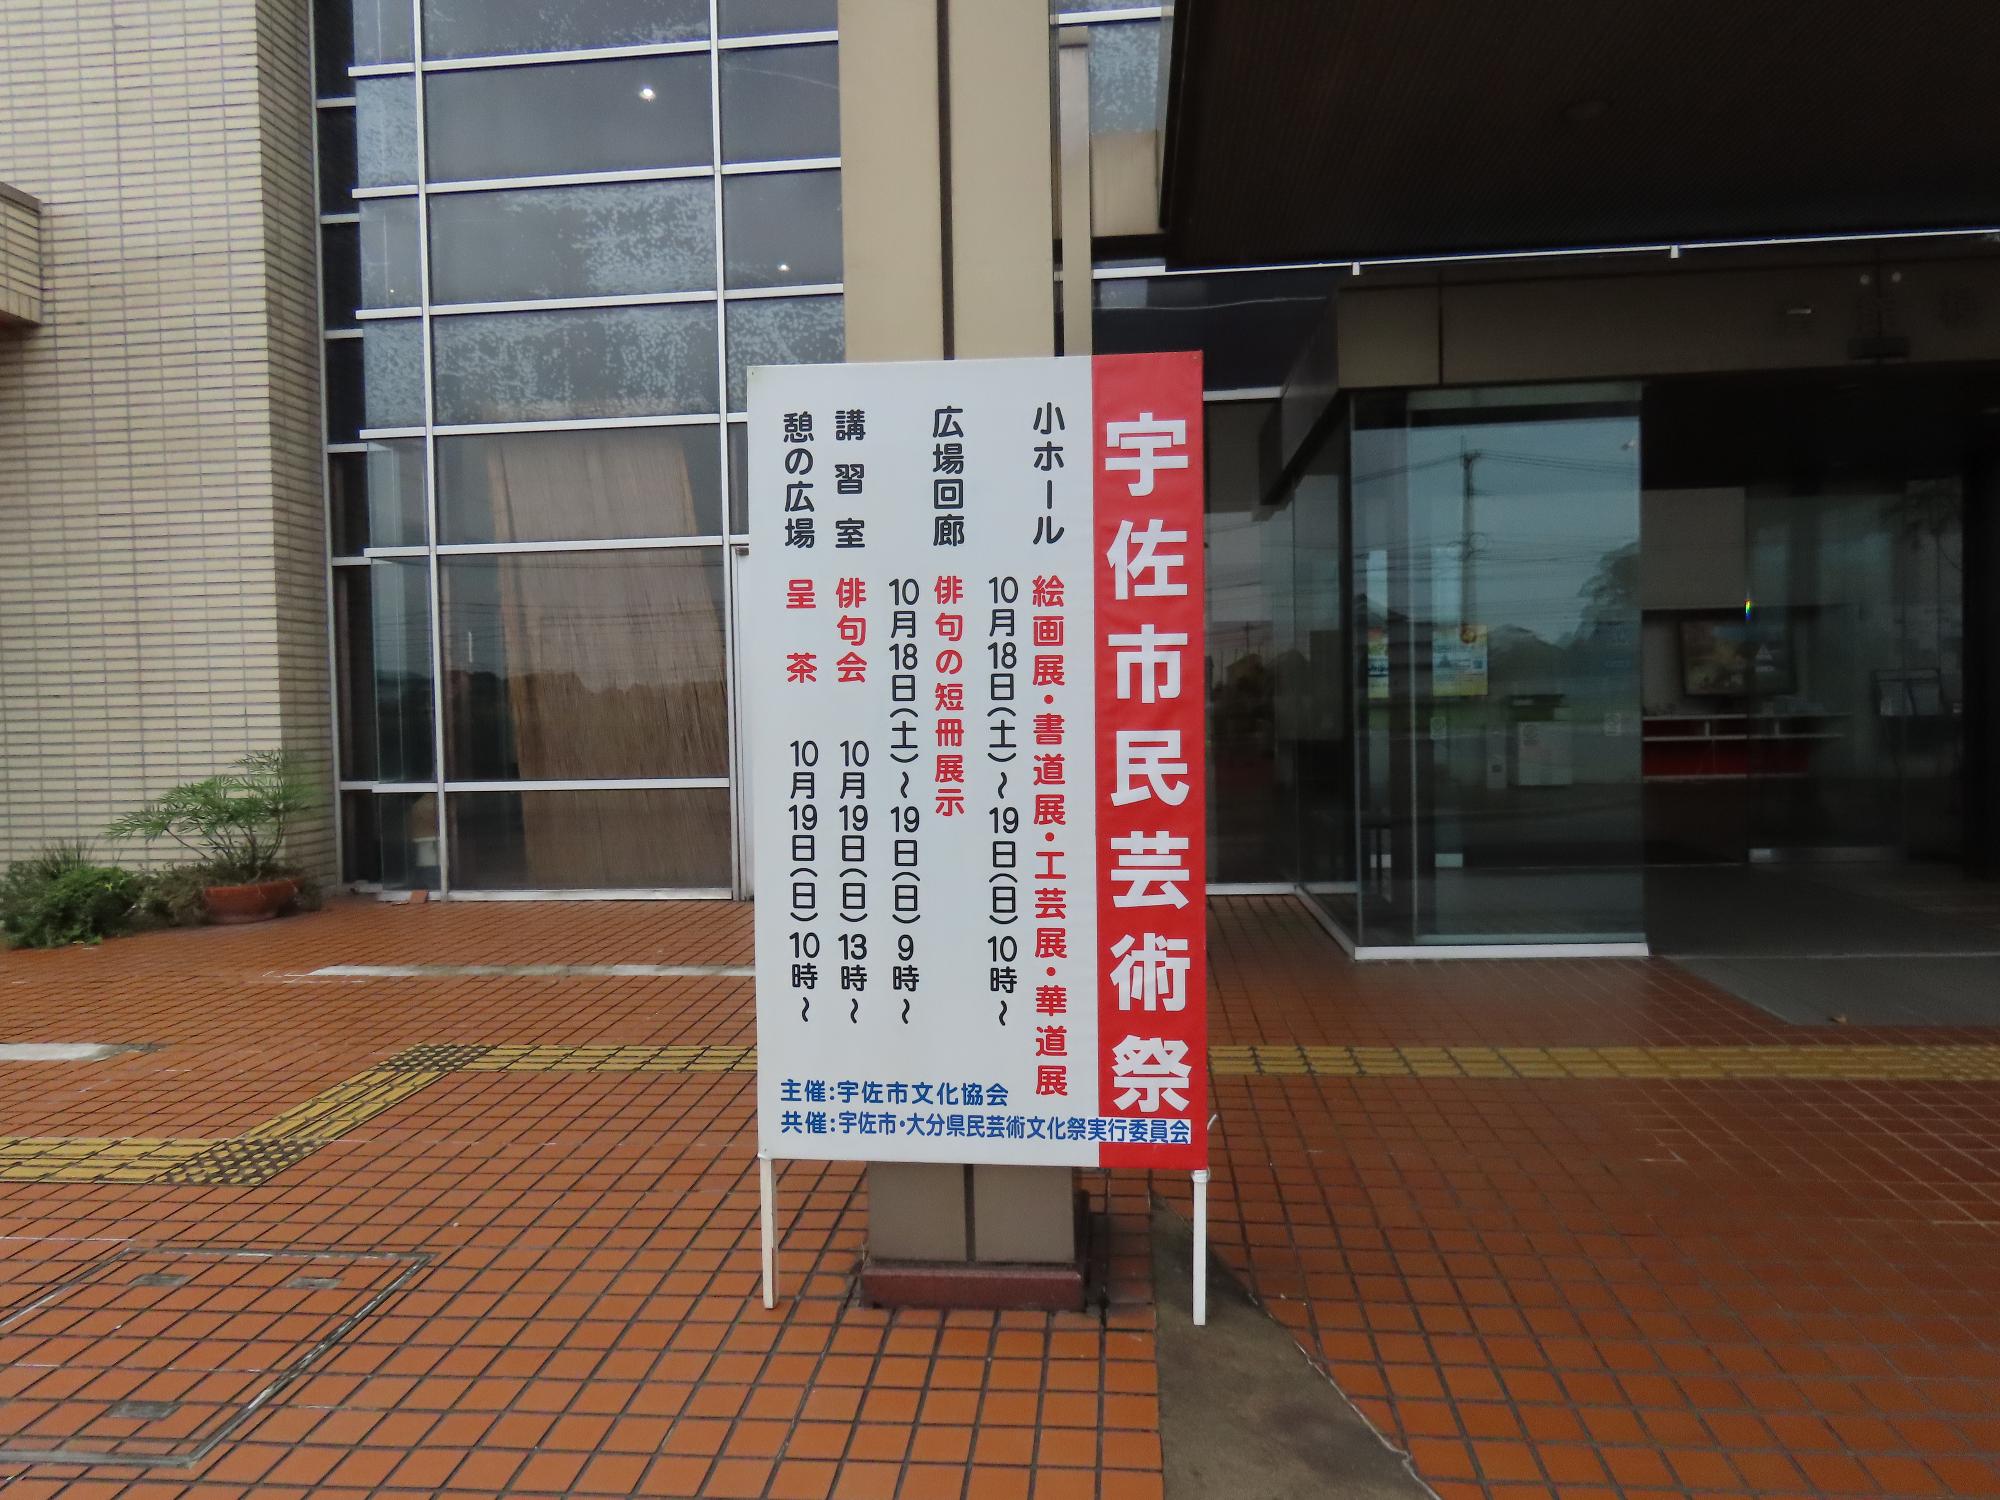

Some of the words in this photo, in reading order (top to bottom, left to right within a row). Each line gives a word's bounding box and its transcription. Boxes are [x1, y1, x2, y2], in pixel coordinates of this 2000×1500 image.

[784, 411, 815, 549] 憩の広場
[835, 409, 866, 549] 講習室
[932, 406, 965, 547] 広場回廊
[1032, 402, 1066, 545] 小ホール
[786, 578, 817, 683] 呈茶
[835, 577, 868, 683] 俳句会
[934, 575, 965, 817] 俳句の短冊展示
[1105, 412, 1191, 1112] 宇佐市民芸術祭
[780, 1079, 1009, 1107] 主催:宇佐市文化協会
